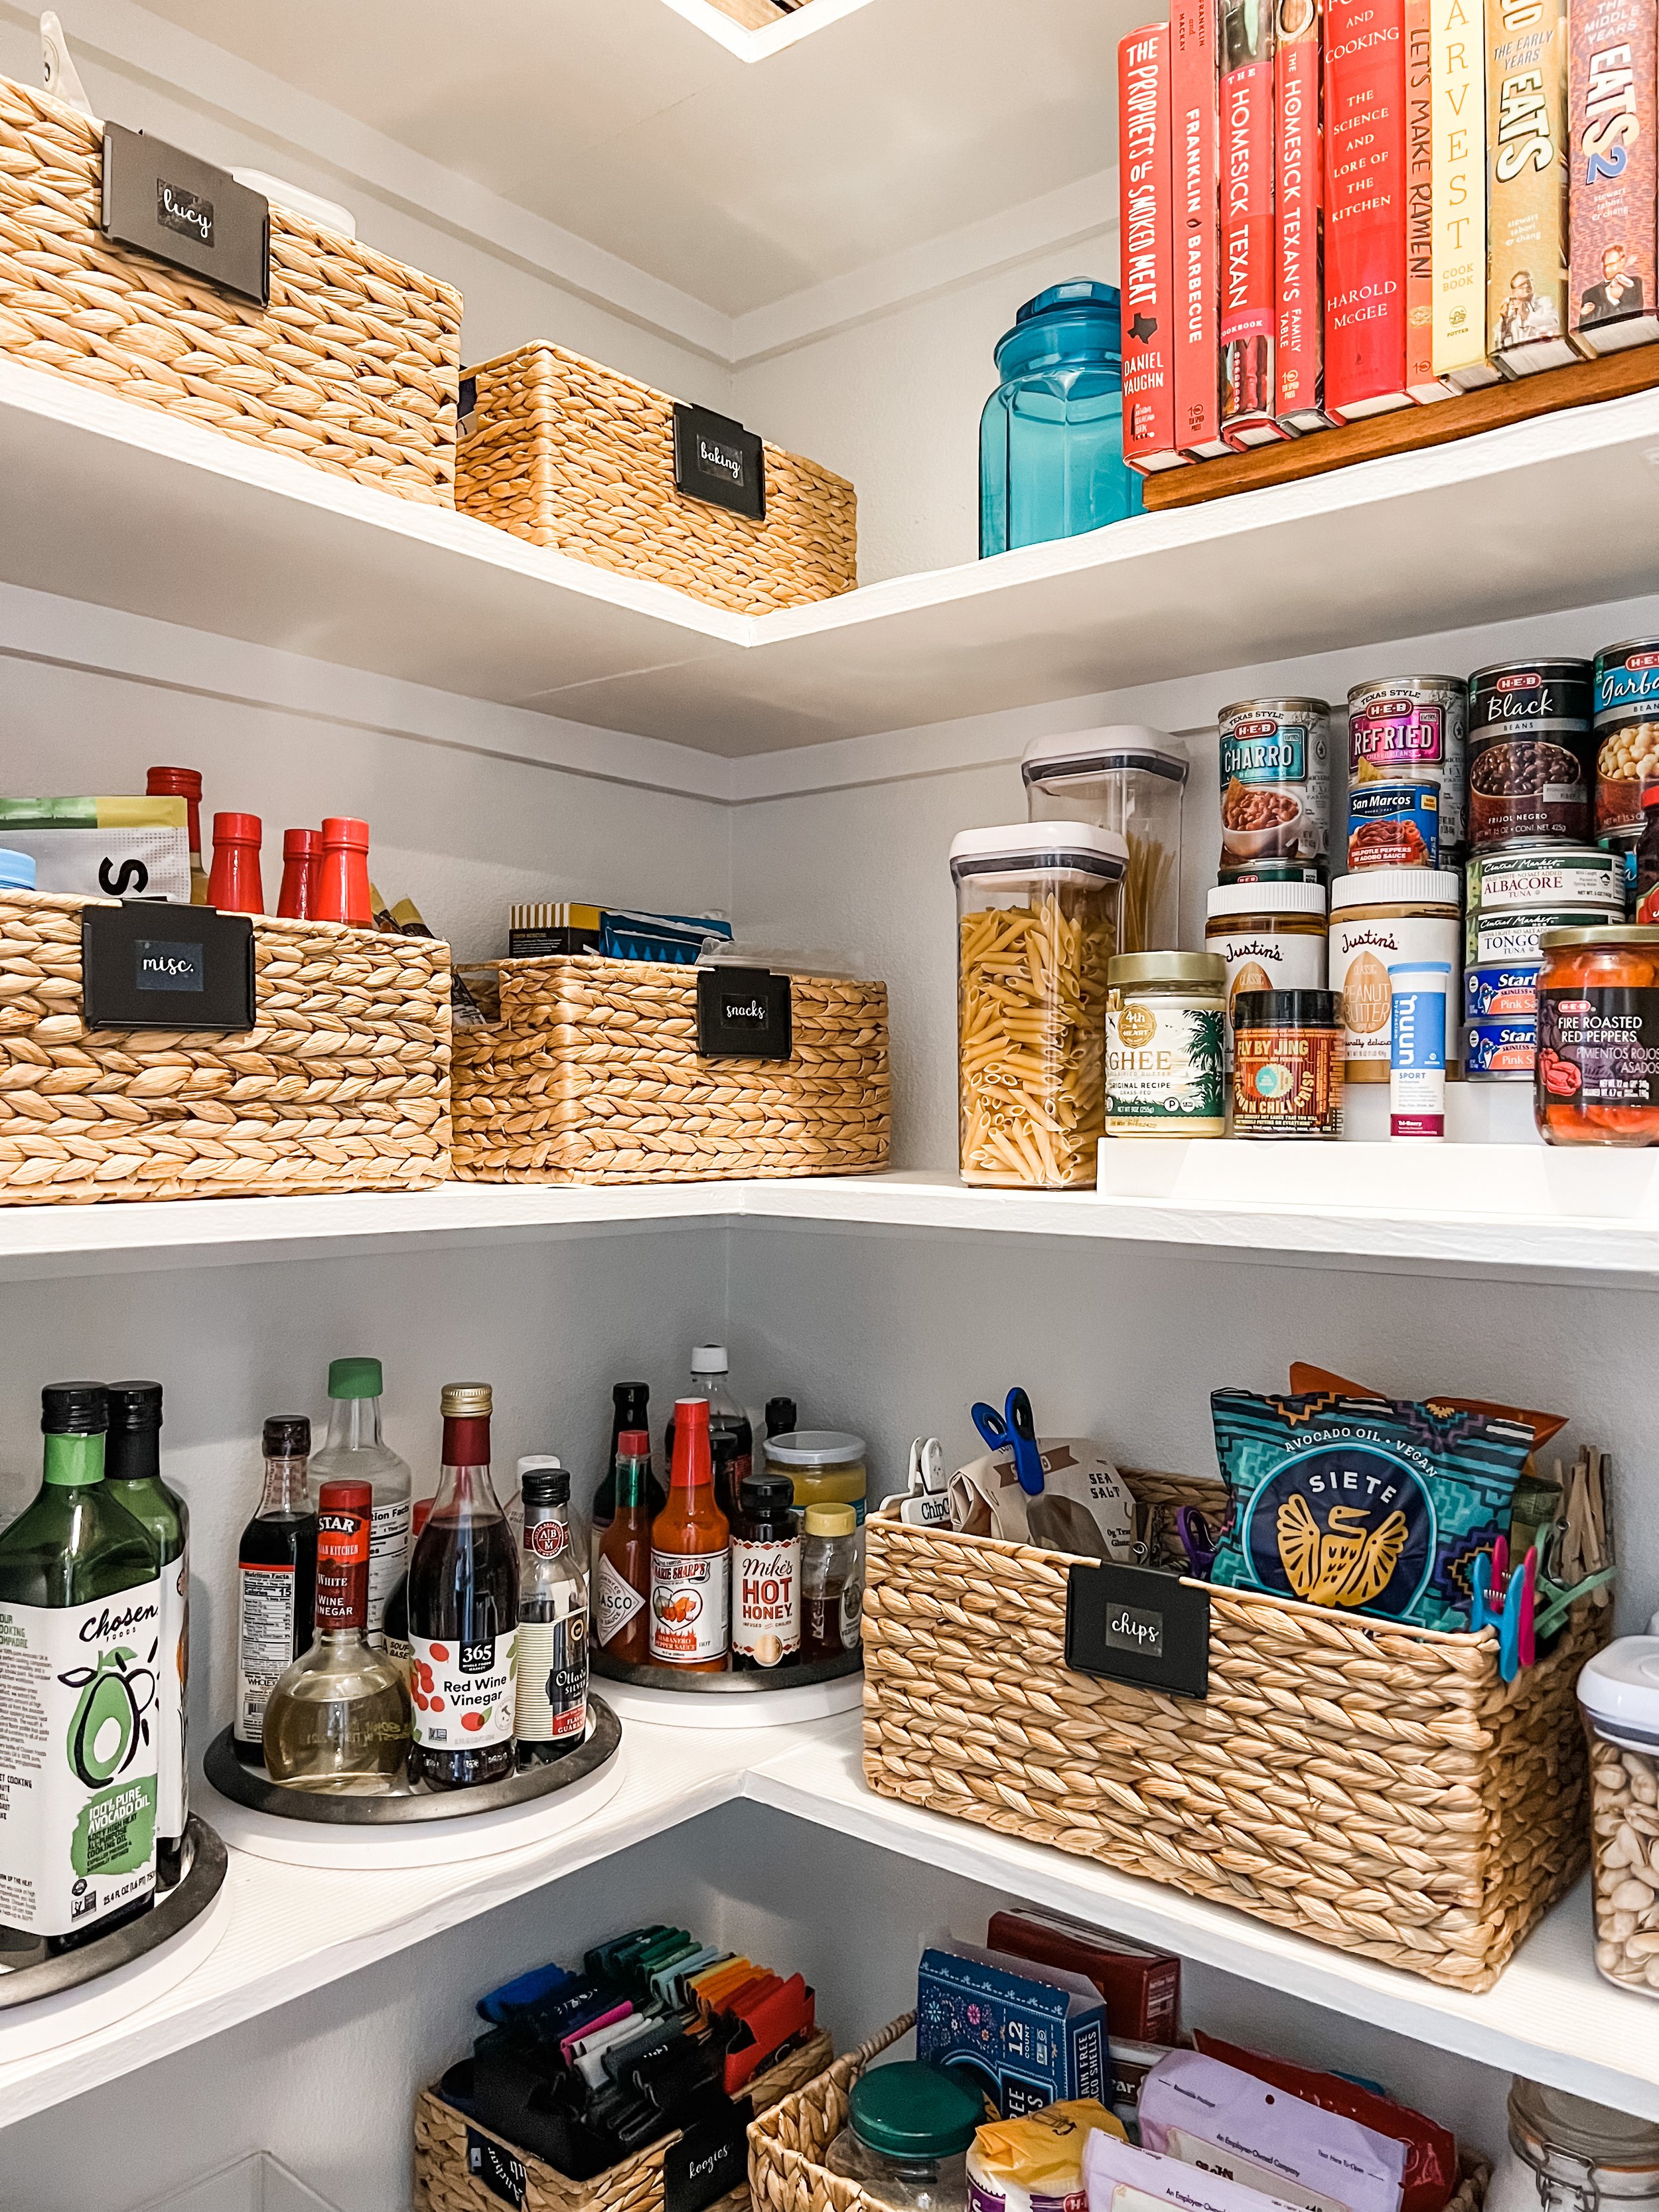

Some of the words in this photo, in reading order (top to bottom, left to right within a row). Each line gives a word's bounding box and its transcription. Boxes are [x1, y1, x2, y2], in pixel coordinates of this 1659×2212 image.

[1346, 10, 1374, 29] AND
[1585, 5, 1640, 34] MIDDLE
[1588, 19, 1637, 44] YEARS
[1127, 37, 1159, 66] THE
[1326, 27, 1400, 64] COOKING
[1494, 42, 1513, 61] THE
[1516, 31, 1553, 50] EARLY
[1410, 28, 1431, 88] LET'S
[1505, 48, 1540, 70] YEARS
[1228, 68, 1256, 84] THE
[1347, 90, 1374, 107] THE
[1581, 42, 1640, 161] EATS
[1127, 66, 1159, 157] PROPHETS
[1334, 108, 1389, 134] SCIENCE
[1496, 68, 1554, 183] EATS
[1283, 79, 1302, 202] HOMESICK
[1346, 134, 1374, 151] AND
[1411, 100, 1431, 175] MAKE
[1186, 108, 1201, 214] FRANKLIN
[1228, 89, 1249, 217] HOMESICK
[1130, 160, 1154, 183] OF
[1334, 158, 1367, 178] LORE
[1370, 152, 1389, 166] OF
[1347, 177, 1374, 194] THE
[1593, 186, 1626, 202] stewart
[163, 188, 212, 239] lucy
[1127, 183, 1157, 254] SMOKED
[1331, 195, 1392, 222] KITCHEN
[1410, 184, 1432, 279] RAMEN!
[1283, 206, 1301, 302] TEXAN'S
[1229, 224, 1248, 309] TEXAN
[1443, 262, 1474, 279] COOK
[1128, 252, 1157, 305] MEAT
[1187, 234, 1202, 343] BARBECUE
[1443, 275, 1474, 293] BOOK
[1327, 281, 1398, 312] HAROLD
[1222, 320, 1263, 337] OOKBOOK
[1280, 311, 1289, 348] TABLE
[1291, 309, 1301, 352] FAMILY
[1124, 352, 1163, 377] DANIEL
[1123, 372, 1163, 397] VAUGHN
[701, 441, 741, 479] baking
[1360, 691, 1387, 705] TEXAS
[1390, 690, 1421, 698] STYLE
[1487, 689, 1553, 721] Black
[1229, 711, 1253, 726] TEXAS
[1256, 711, 1285, 719] STYLE
[1504, 722, 1534, 731] BEANS
[1354, 725, 1433, 756] REFRIED
[1225, 745, 1292, 773] CHARRO
[1352, 798, 1368, 810] San
[1369, 795, 1411, 807] Marcos
[1488, 815, 1513, 824] FRIJOL
[1484, 860, 1518, 873] Central
[1518, 859, 1565, 869] Market
[1484, 877, 1563, 895] ALBACORE
[1480, 917, 1512, 928] Central
[1226, 940, 1283, 962] Justin's
[1342, 929, 1398, 953] Justin's
[142, 956, 194, 974] misc.
[1240, 974, 1263, 986] CLASSIC
[1344, 983, 1390, 1003] PEANUT
[726, 1000, 766, 1021] snacks
[1344, 1003, 1390, 1022] BUTTER
[1501, 1000, 1522, 1009] Pink
[1125, 1011, 1145, 1023] 4th
[1558, 1017, 1579, 1029] FIRE
[1583, 1016, 1642, 1029] ROASTED
[1399, 995, 1417, 1065] nuun
[1561, 1031, 1583, 1043] RED
[1587, 1030, 1637, 1043] PEPPERS
[1238, 1041, 1252, 1055] FLY
[1254, 1040, 1271, 1055] BY
[1576, 1047, 1628, 1059] PIMIENTOS
[1110, 1051, 1171, 1070] GHEE
[1502, 1055, 1523, 1065] Pink
[1260, 1100, 1293, 1114] CHILI
[1293, 1070, 1315, 1108] CRISP
[1284, 1427, 1351, 1454] AVOCADO
[1356, 1428, 1382, 1443] OIL
[1396, 1439, 1438, 1478] VEGAN
[1089, 1473, 1113, 1485] SEA
[1309, 1471, 1397, 1504] SIETE
[1090, 1486, 1120, 1499] SALT
[319, 1516, 354, 1532] STAR
[330, 1544, 358, 1556] KITCHEN
[673, 1563, 705, 1579] SHARP'S
[743, 1554, 793, 1577] Mike's
[318, 1574, 348, 1586] WHITE
[743, 1577, 792, 1605] HOT
[317, 1606, 353, 1615] INEGAR
[318, 1594, 344, 1606] WINE
[600, 1594, 632, 1609] ASCO
[743, 1603, 792, 1619] HONEY
[79, 1605, 158, 1642] Chosen
[1112, 1612, 1159, 1645] chips
[658, 1634, 691, 1643] HABANERO
[390, 1649, 409, 1659] BASE
[463, 1645, 492, 1662] 365
[444, 1680, 470, 1692] Red
[475, 1676, 507, 1690] Wine
[451, 1690, 502, 1706] Vinegar
[7, 1775, 32, 1789] COOKING
[88, 1804, 133, 1834] AVOCADO
[135, 1795, 151, 1811] OIL
[90, 1798, 115, 1821] 100%
[115, 1786, 141, 1806] PURE
[88, 1841, 115, 1859] COOKING
[1009, 2021, 1023, 2056] 12
[1078, 2035, 1089, 2068] FREE
[1088, 2031, 1099, 2075] SHELLS
[1274, 2160, 1300, 2177] Company
